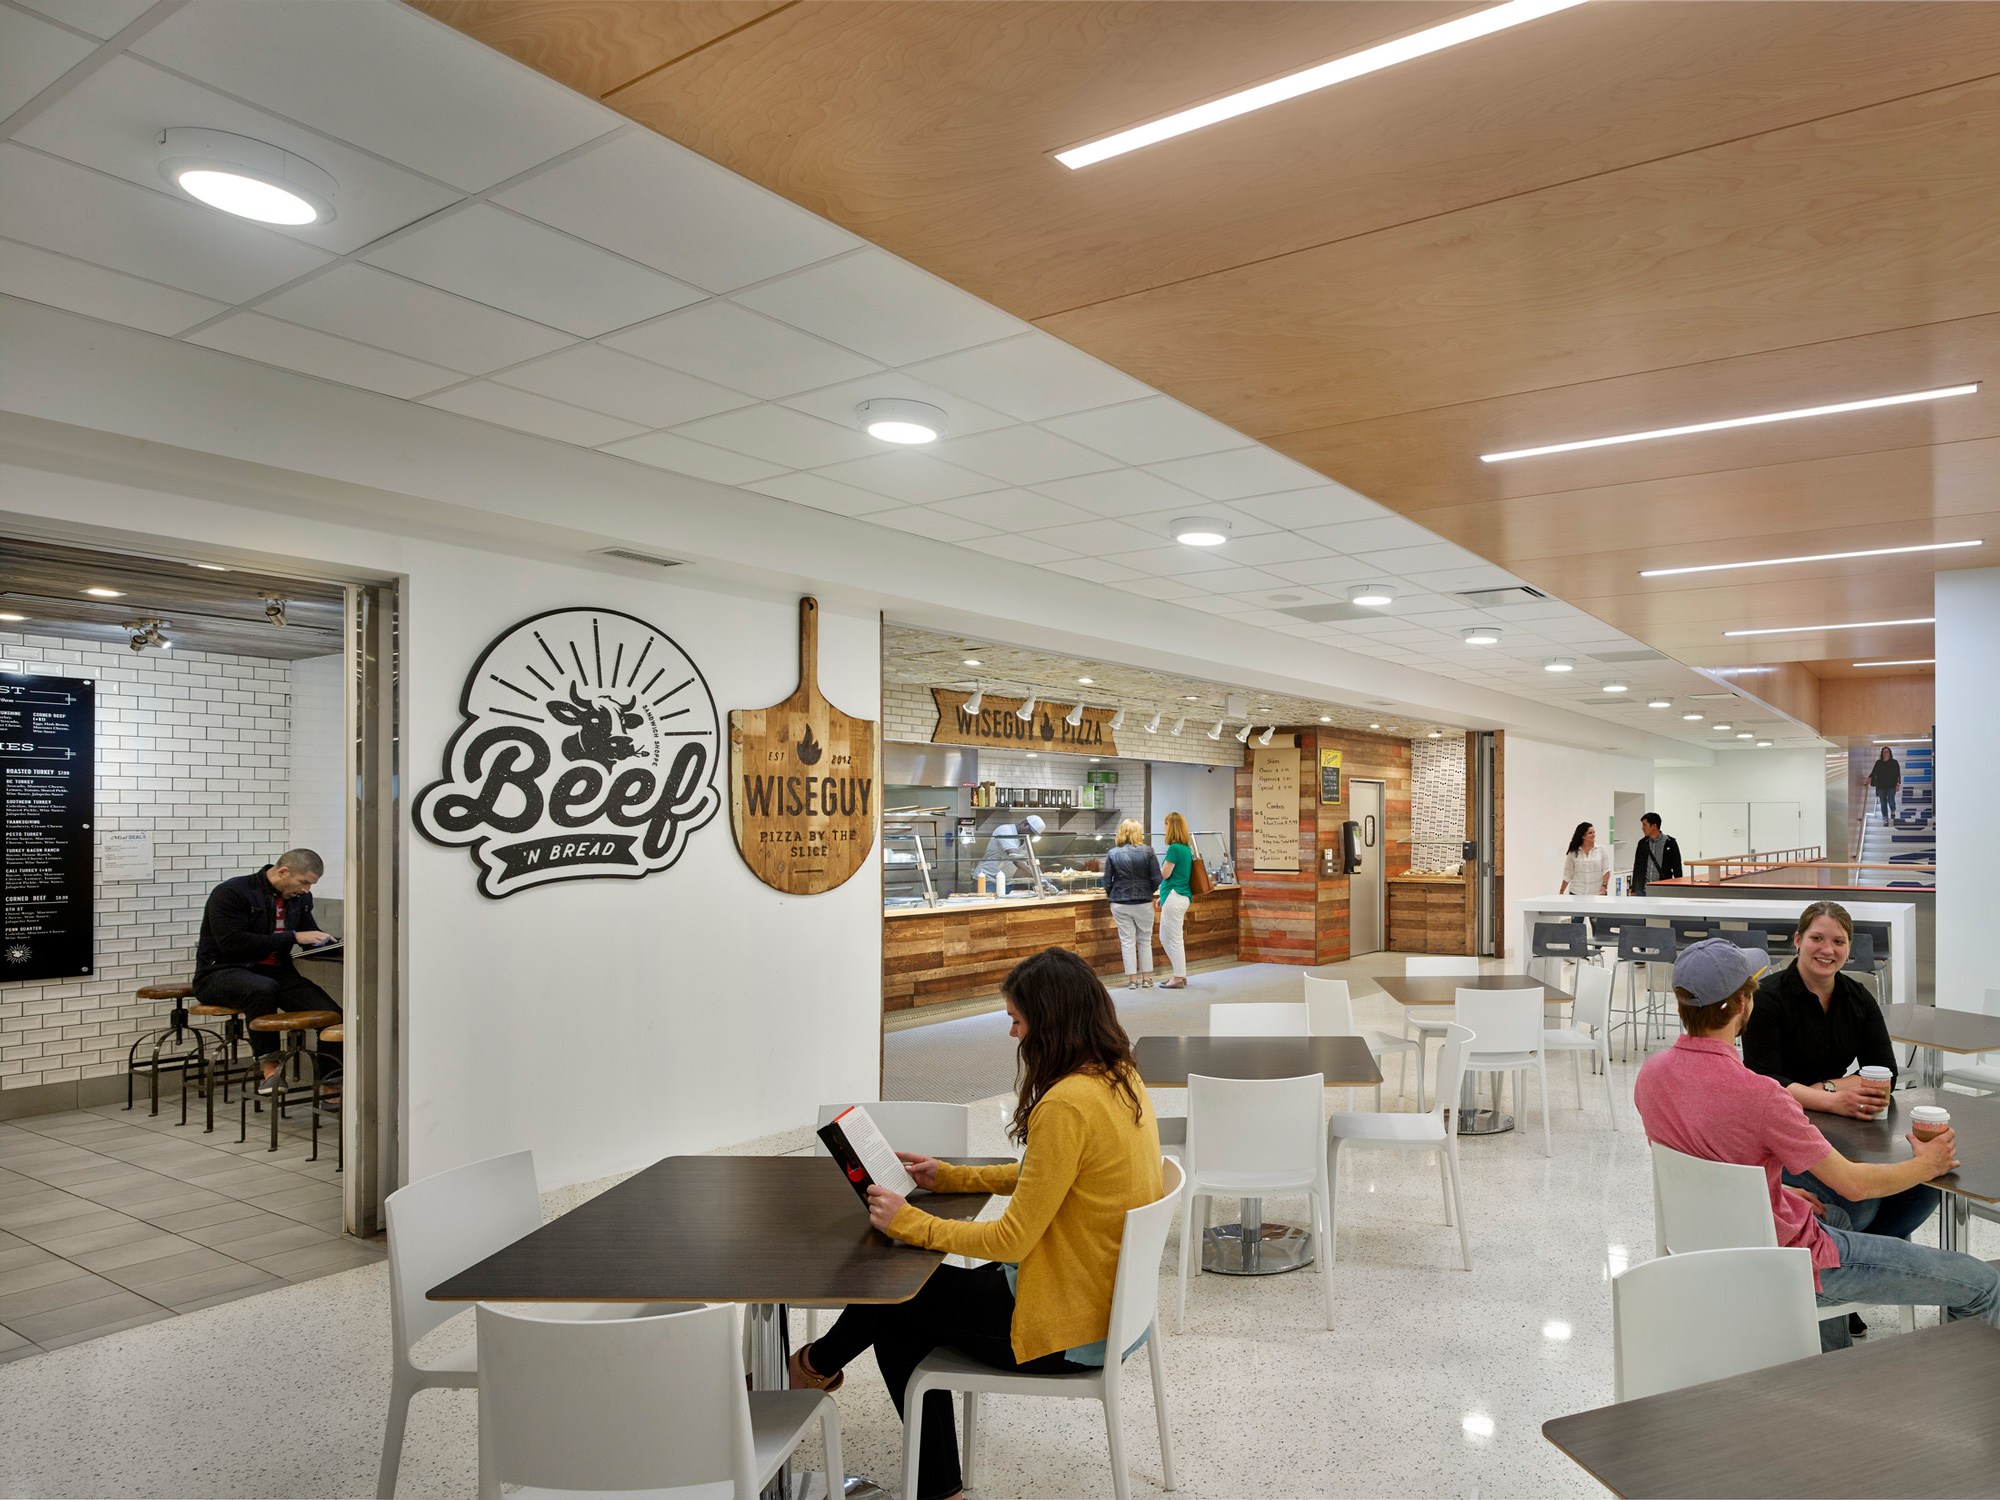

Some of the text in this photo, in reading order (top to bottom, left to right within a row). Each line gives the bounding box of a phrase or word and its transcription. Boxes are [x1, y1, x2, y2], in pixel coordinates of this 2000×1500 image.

[642, 704, 659, 738] SANDWICH
[955, 705, 1103, 745] WISEGUY PIZZA
[652, 741, 660, 767] SHOPPE
[768, 752, 785, 761] EST
[831, 755, 852, 765] 2012
[433, 726, 709, 860] Beef
[743, 774, 872, 817] WISEGUY
[760, 829, 857, 842] PIZZA BY THE
[523, 841, 616, 865] 'N BREAD
[790, 846, 828, 857] SLICE
